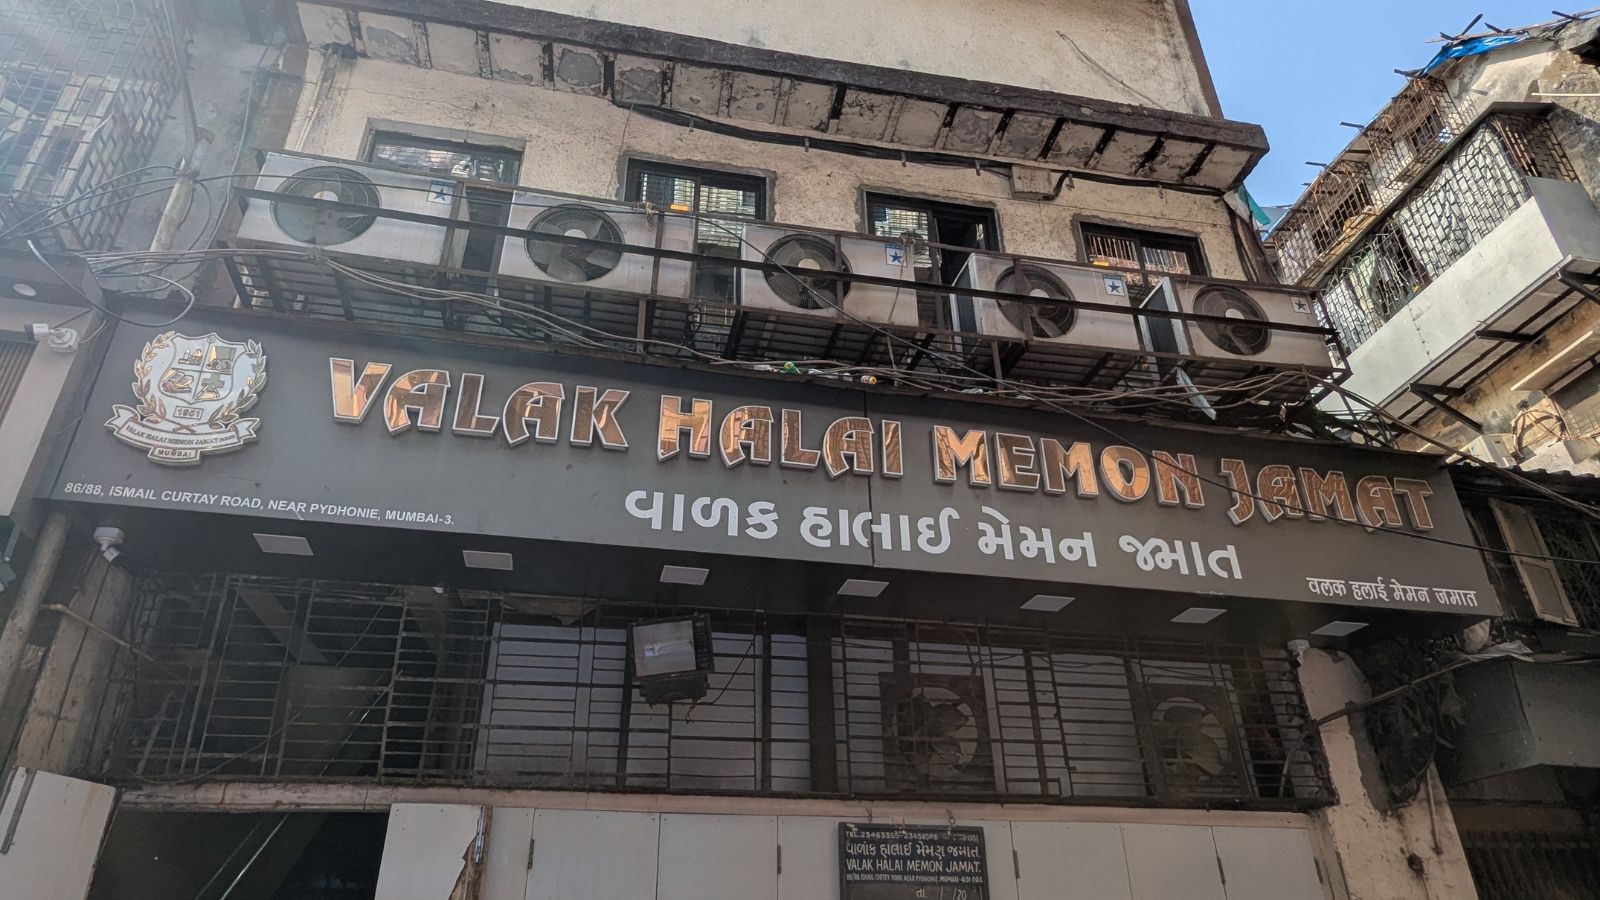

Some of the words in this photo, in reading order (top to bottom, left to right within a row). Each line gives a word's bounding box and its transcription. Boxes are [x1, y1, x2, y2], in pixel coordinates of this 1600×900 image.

[177, 408, 200, 418] 1951
[126, 424, 145, 438] VALAK
[157, 448, 192, 457] MUMBAI
[328, 357, 631, 451] VALAK
[656, 394, 904, 479] HALAI
[931, 424, 1205, 509] MEMON
[1219, 457, 1434, 532] JAMAT
[64, 482, 104, 497] 86/88,
[109, 486, 158, 501] ISMAIL
[161, 490, 218, 505] CURTAY
[220, 495, 264, 511] ROAD,
[268, 499, 307, 514] NEAR
[309, 503, 382, 521] PYDHONIE,
[385, 510, 455, 526] MUMBAI-3.
[624, 490, 780, 540] વાળક
[800, 506, 960, 555] હાલાઈ
[977, 505, 1098, 568] મેમન
[1118, 534, 1243, 579] જમાત
[1306, 577, 1347, 597] वलक
[1349, 576, 1390, 602] हलाई
[1390, 578, 1430, 603] मेमन
[1432, 587, 1478, 607] जमात
[846, 859, 874, 871] VALAK
[876, 859, 903, 871] HALAI
[906, 860, 942, 872] MEMON
